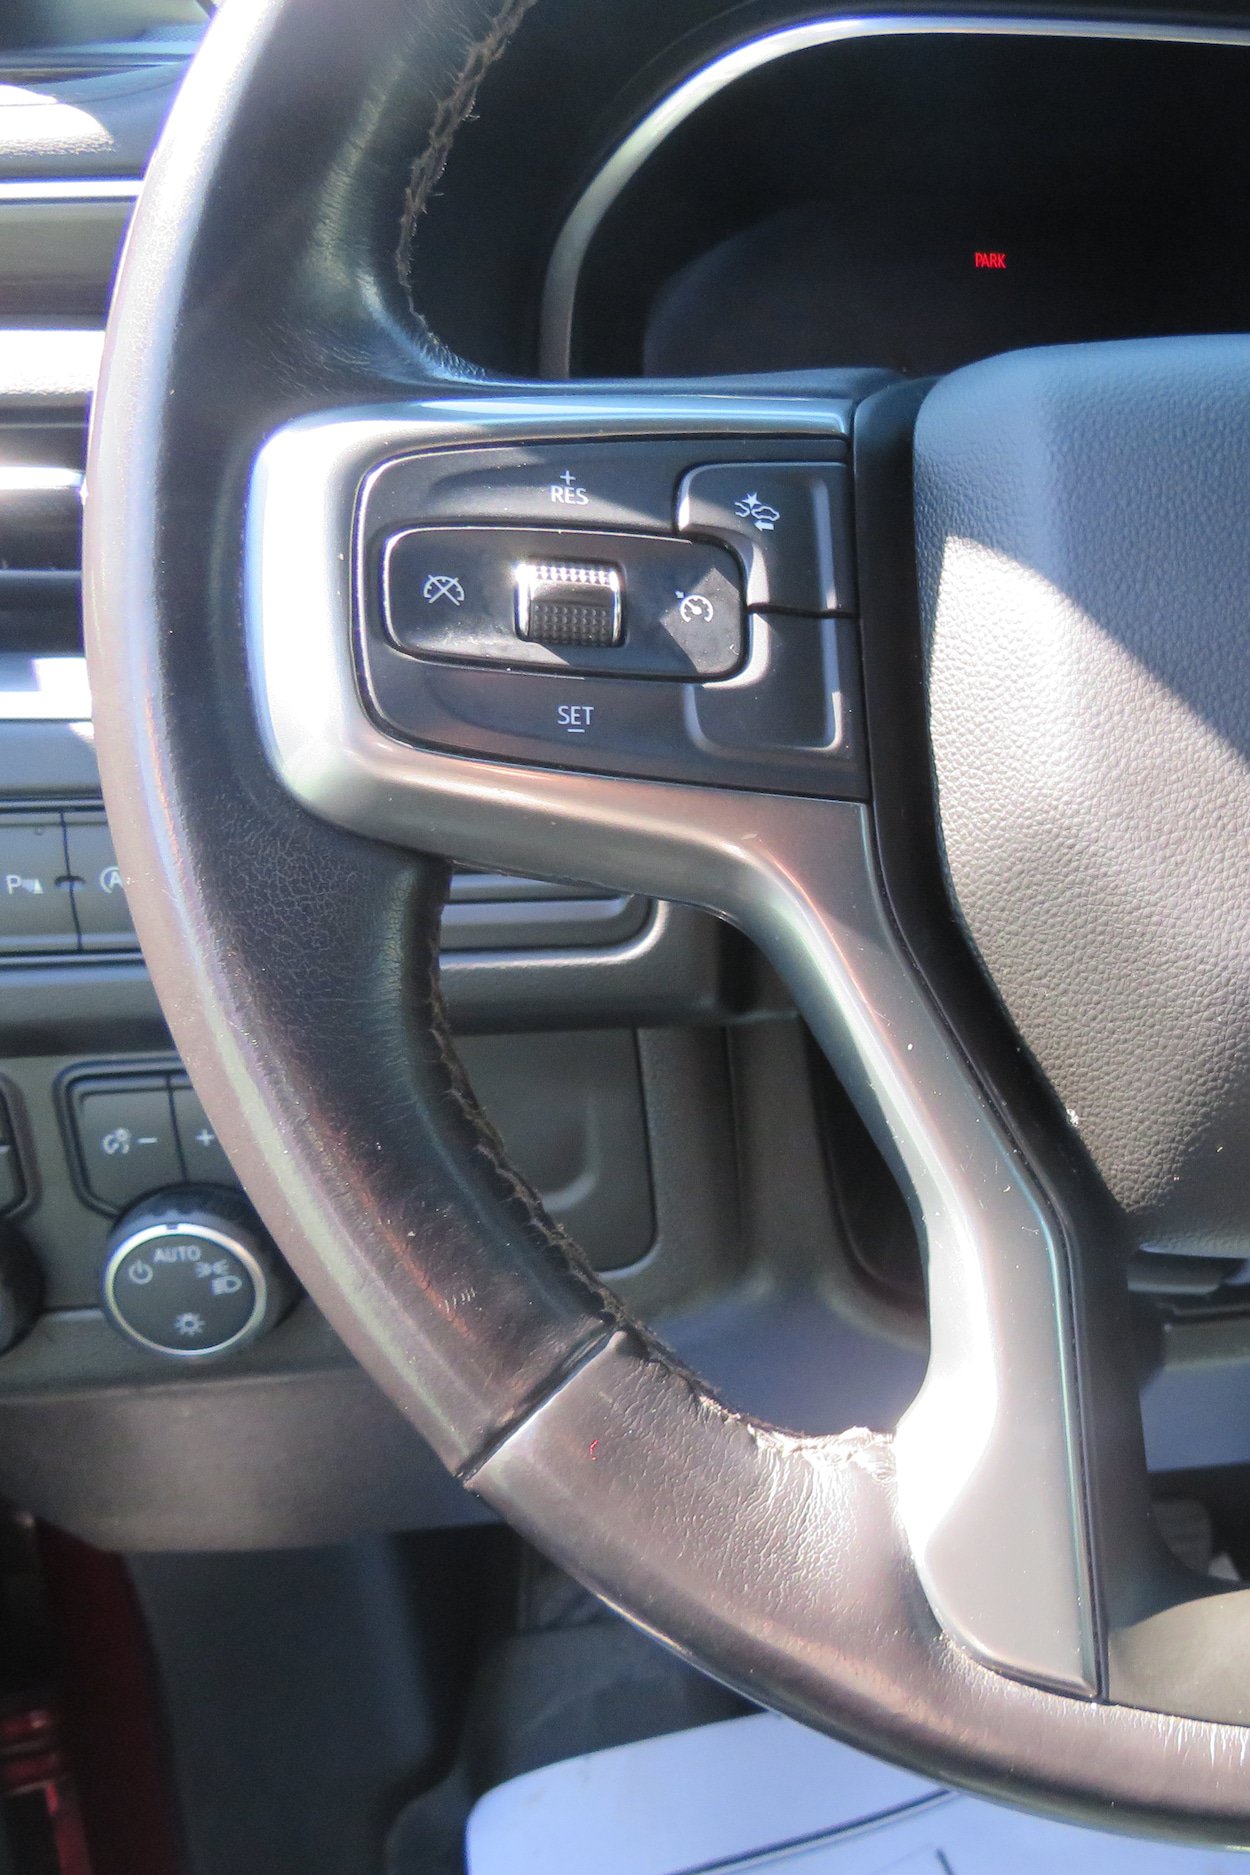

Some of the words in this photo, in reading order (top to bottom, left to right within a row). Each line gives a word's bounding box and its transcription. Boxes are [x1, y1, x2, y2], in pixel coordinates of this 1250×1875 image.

[974, 251, 1007, 269] PARK
[551, 485, 589, 505] RES
[557, 705, 595, 725] SET
[153, 1244, 201, 1263] AUTO
